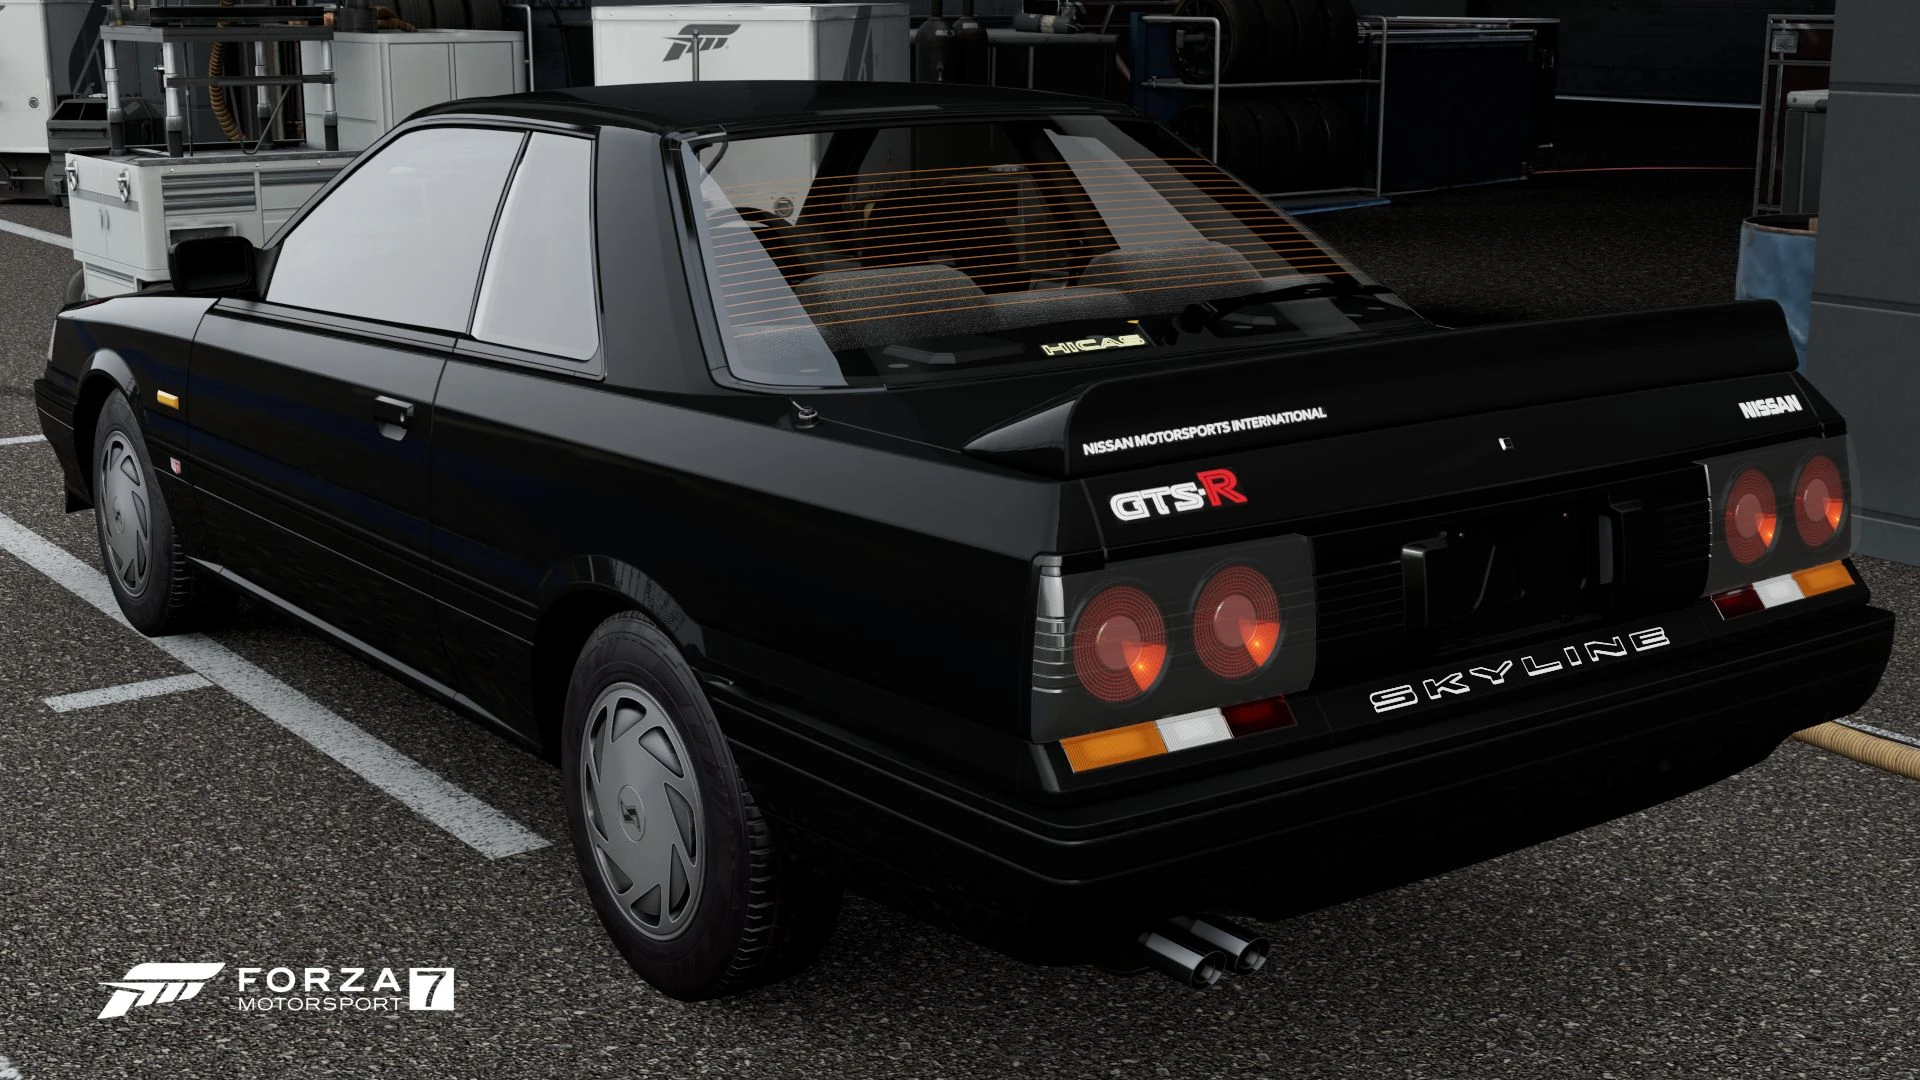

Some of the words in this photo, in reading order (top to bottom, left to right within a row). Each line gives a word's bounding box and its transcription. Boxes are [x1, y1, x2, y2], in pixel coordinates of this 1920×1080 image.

[1041, 334, 1146, 356] HICAS
[1738, 394, 1803, 419] NISSAN
[1083, 434, 1134, 456] NISSAN
[1134, 418, 1231, 448] MOTORSPORTS
[1231, 406, 1328, 433] INTERNATIONAL
[1370, 627, 1671, 713] SKYLINE
